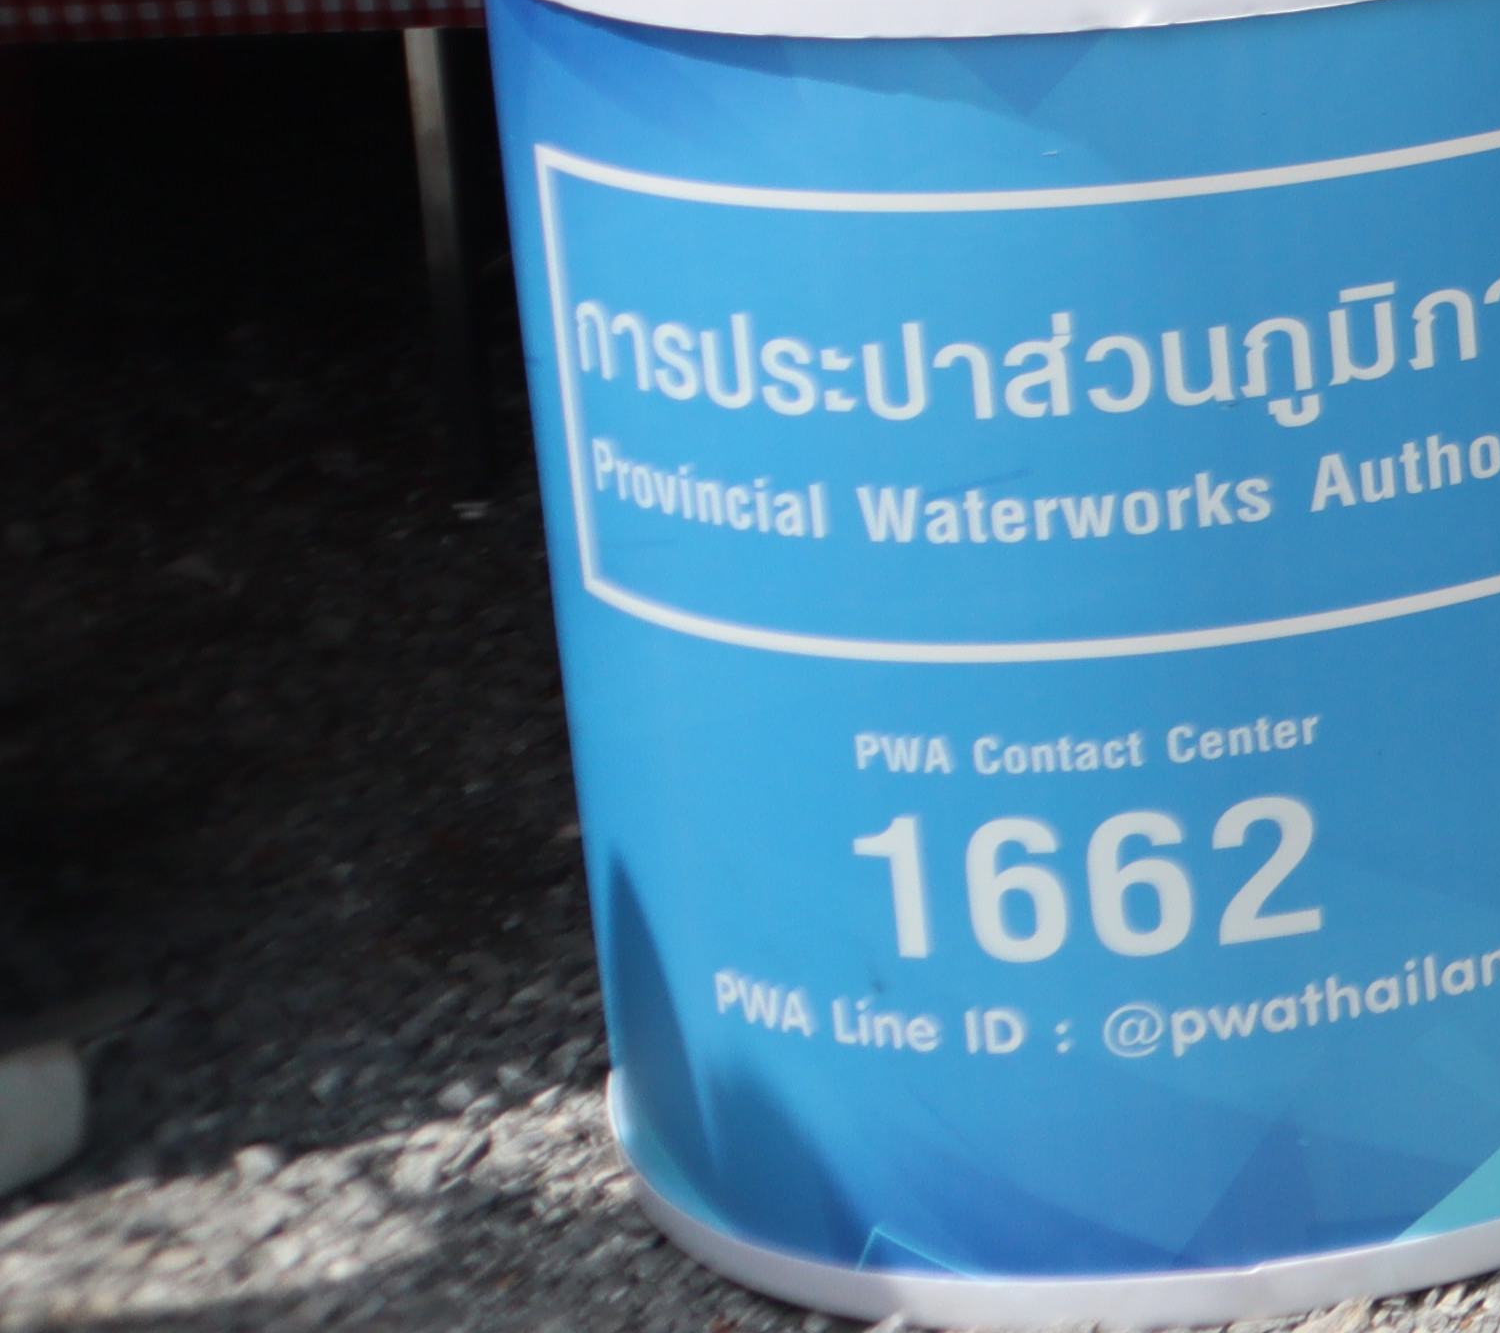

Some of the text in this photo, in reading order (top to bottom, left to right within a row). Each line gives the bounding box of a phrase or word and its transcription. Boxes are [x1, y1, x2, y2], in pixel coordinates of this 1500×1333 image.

[591, 435, 828, 540] Provincial
[856, 467, 1274, 547] Waterworks
[854, 710, 1321, 779] PWA Contact Center
[851, 793, 1324, 966] 1662
[713, 970, 813, 1038] PWA
[833, 995, 940, 1055] Line
[965, 1007, 1025, 1055] ID
